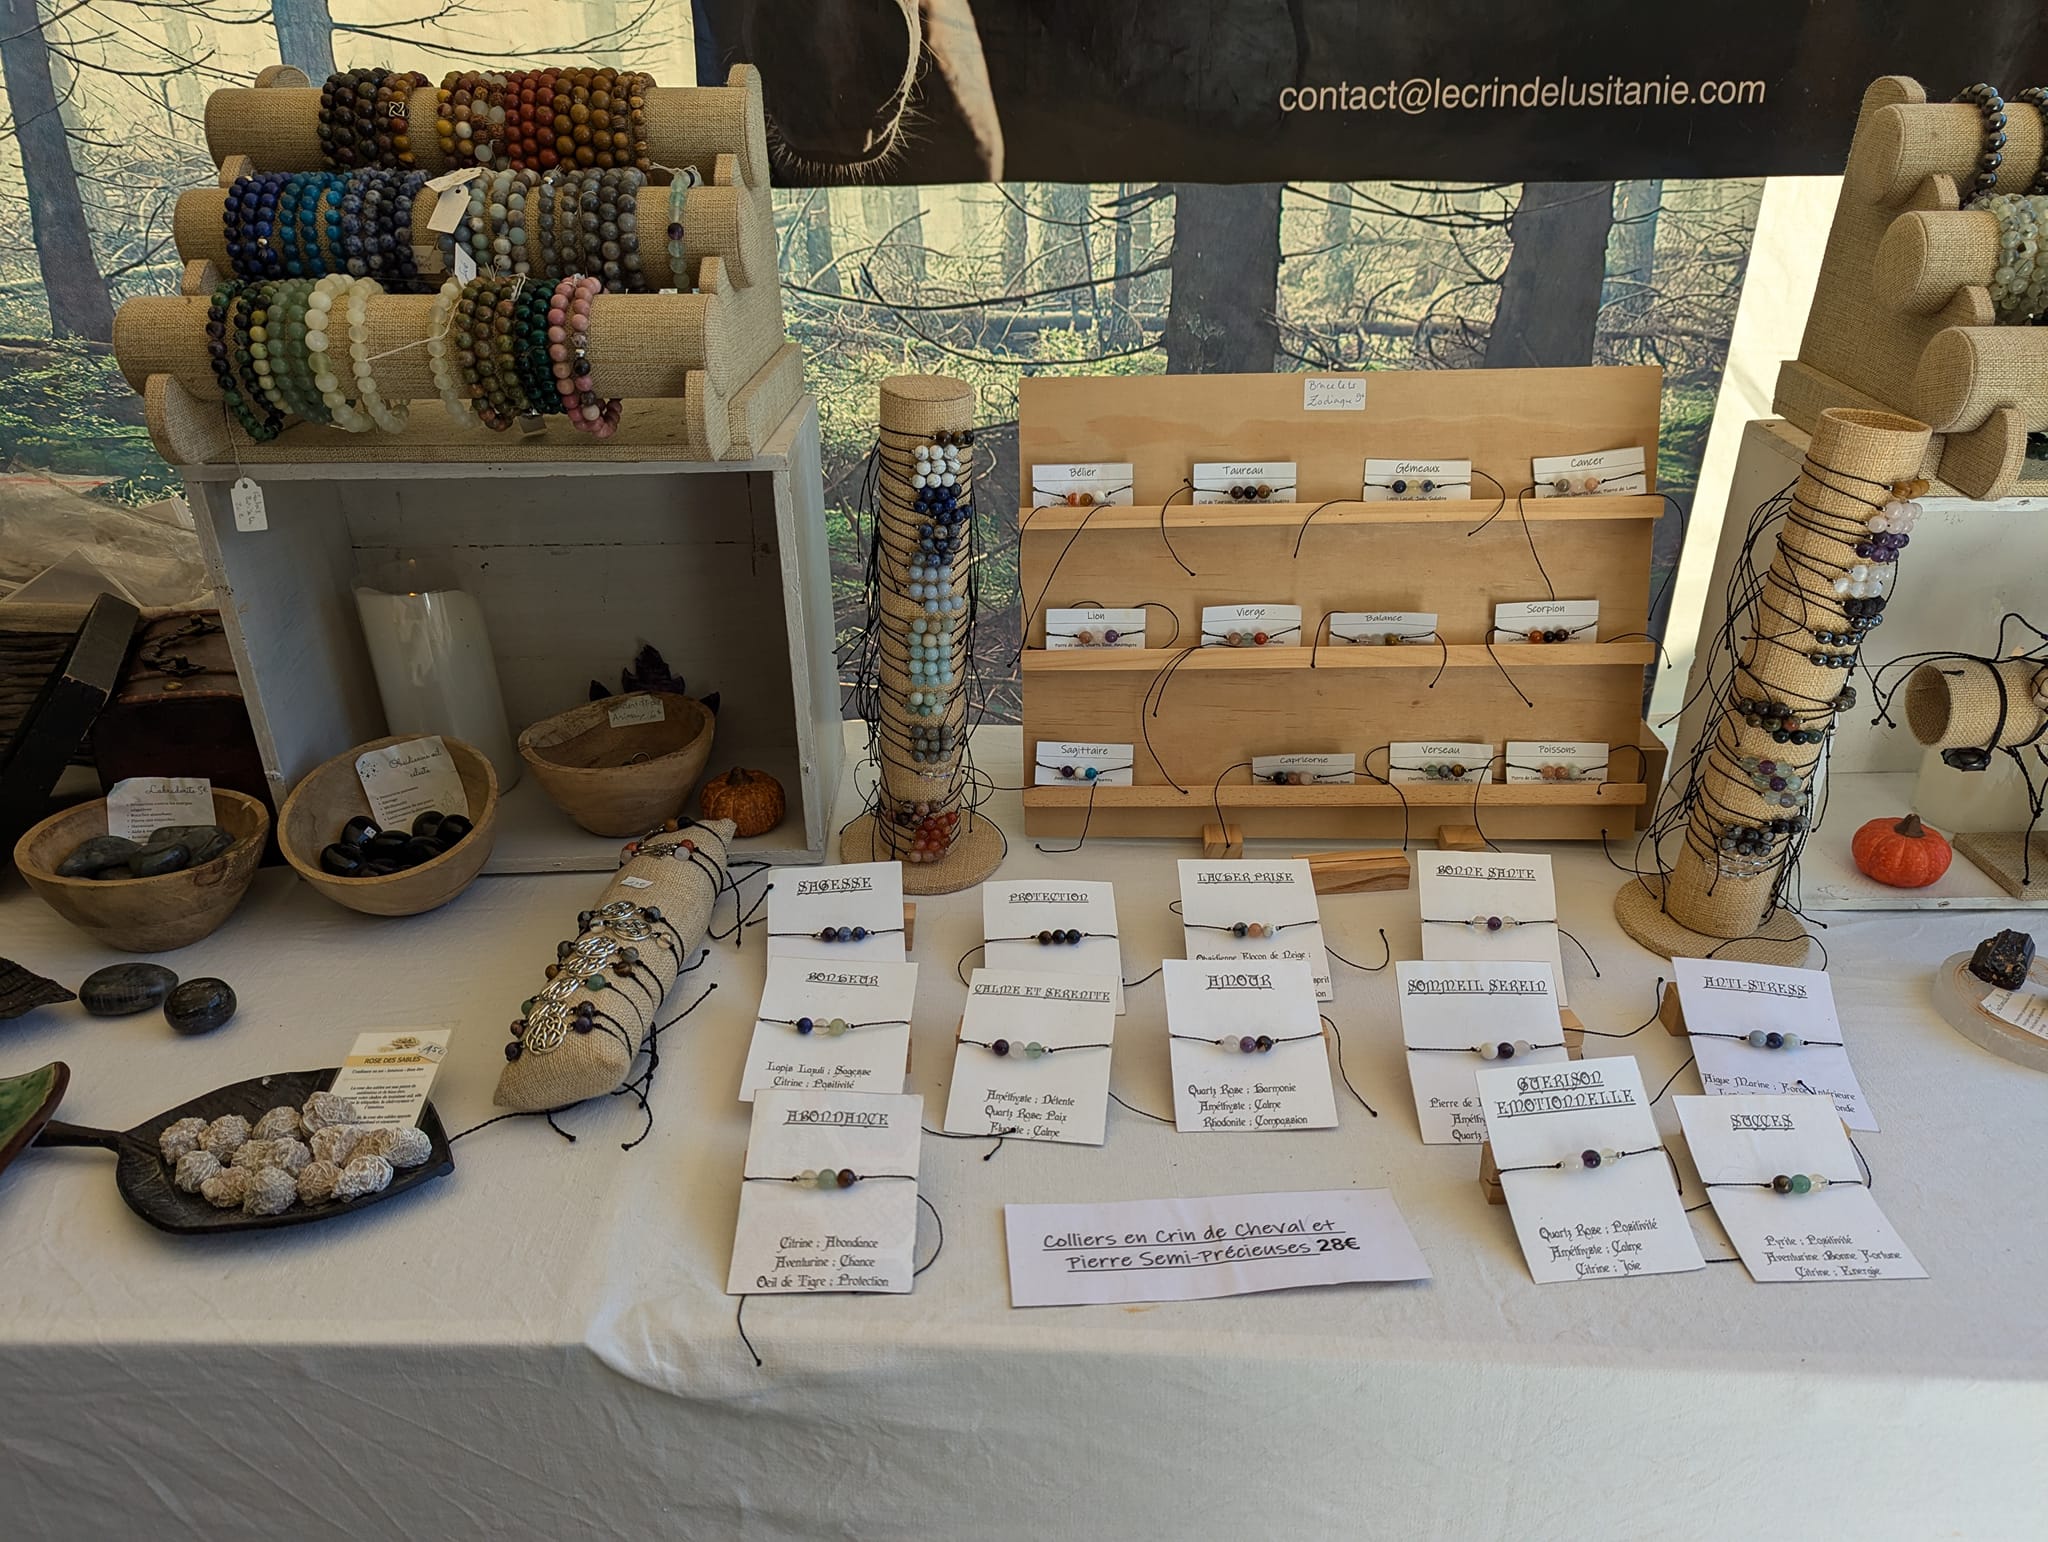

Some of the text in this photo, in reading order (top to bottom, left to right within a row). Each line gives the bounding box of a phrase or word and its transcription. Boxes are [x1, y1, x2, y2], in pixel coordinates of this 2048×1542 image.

[1279, 76, 1766, 114] contact@lecrindelusitanie.com
[1395, 463, 1440, 474] Gémeaux
[1570, 457, 1604, 468] Cancer
[1069, 468, 1097, 477] Bélier
[1222, 466, 1264, 475] Taureau
[1087, 611, 1105, 620] Lion
[1236, 608, 1266, 619] Vierge
[1526, 604, 1565, 614] Scorpion
[1061, 744, 1108, 757] Sagittaire
[1421, 745, 1460, 754] Verseau
[1538, 745, 1576, 753] Poissons
[1197, 872, 1295, 884] LACHER PRISE
[1436, 865, 1536, 880] BONNE SANTE
[797, 877, 872, 894] SAGESSE
[1009, 892, 1088, 903] PROTECTION
[806, 971, 879, 986] BONHEUR
[1205, 974, 1275, 989] AMOUR
[973, 983, 1110, 1002] CALME ET SERENITE
[1408, 979, 1548, 995] SOMMEIL SEREIN
[1703, 976, 1808, 998] ANTI-STRESS
[364, 1057, 382, 1065] ROSE
[397, 1056, 421, 1064] SABLES
[771, 1076, 803, 1088] Citrine
[1517, 1070, 1604, 1093] GUERISON
[1702, 1073, 1730, 1086] Aigue
[1734, 1077, 1770, 1089] Marine
[983, 1089, 1032, 1105] Améthyste
[1040, 1094, 1075, 1106] Détente
[1188, 1084, 1216, 1098] Quartz
[1220, 1084, 1243, 1097] Rose
[1253, 1083, 1296, 1096] Harmonie
[1198, 1100, 1246, 1114] Améthyste
[1254, 1099, 1281, 1113] Calme
[1429, 1097, 1459, 1108] Pierre
[1462, 1096, 1473, 1107] de
[1494, 1090, 1636, 1117] EMOTIONNELLE
[784, 1110, 889, 1127] ABONDANCE
[984, 1105, 1014, 1119] Quartz
[1045, 1110, 1068, 1122] Paix
[1203, 1116, 1247, 1130] Rhodonite
[1254, 1115, 1308, 1130] Compassion
[1730, 1113, 1795, 1130] SUCCES
[1031, 1126, 1060, 1139] Calme
[1452, 1129, 1482, 1143] Quartz
[1044, 1218, 1336, 1248] Colliers en Crin de Cheval et
[1539, 1227, 1572, 1242] Quartz
[1575, 1224, 1602, 1239] Rose
[776, 1236, 813, 1253] Citrine
[821, 1235, 879, 1251] Abondance
[1548, 1244, 1603, 1262] Améthyste
[1611, 1240, 1643, 1257] Calme
[1066, 1237, 1361, 1270] Pierre Semi-Précieuses 28€
[772, 1256, 829, 1271] Aventurine
[837, 1254, 876, 1270] Chance
[1575, 1262, 1610, 1279] Citrine
[1618, 1260, 1641, 1275] Joie
[1795, 1266, 1831, 1280] Citrine
[756, 1275, 777, 1288] Oeil
[780, 1274, 793, 1288] de
[798, 1274, 827, 1290] Tigre
[837, 1273, 889, 1287] Protection
